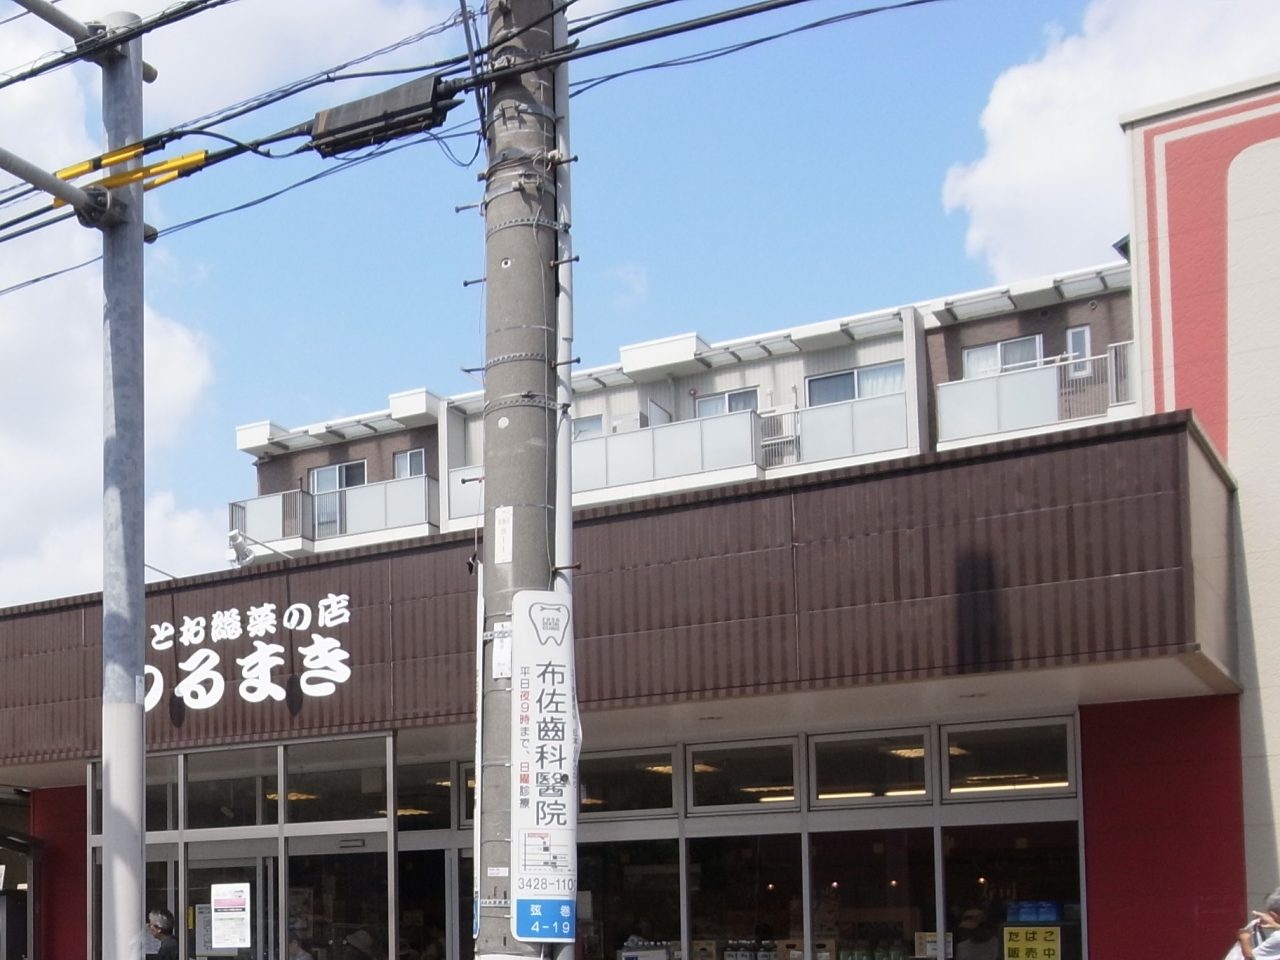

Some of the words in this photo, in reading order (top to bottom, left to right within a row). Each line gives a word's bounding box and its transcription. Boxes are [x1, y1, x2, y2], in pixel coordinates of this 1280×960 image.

[530, 921, 570, 934] 4-19
[1008, 930, 1056, 942] たばこ
[1008, 947, 1056, 959] 販売中
